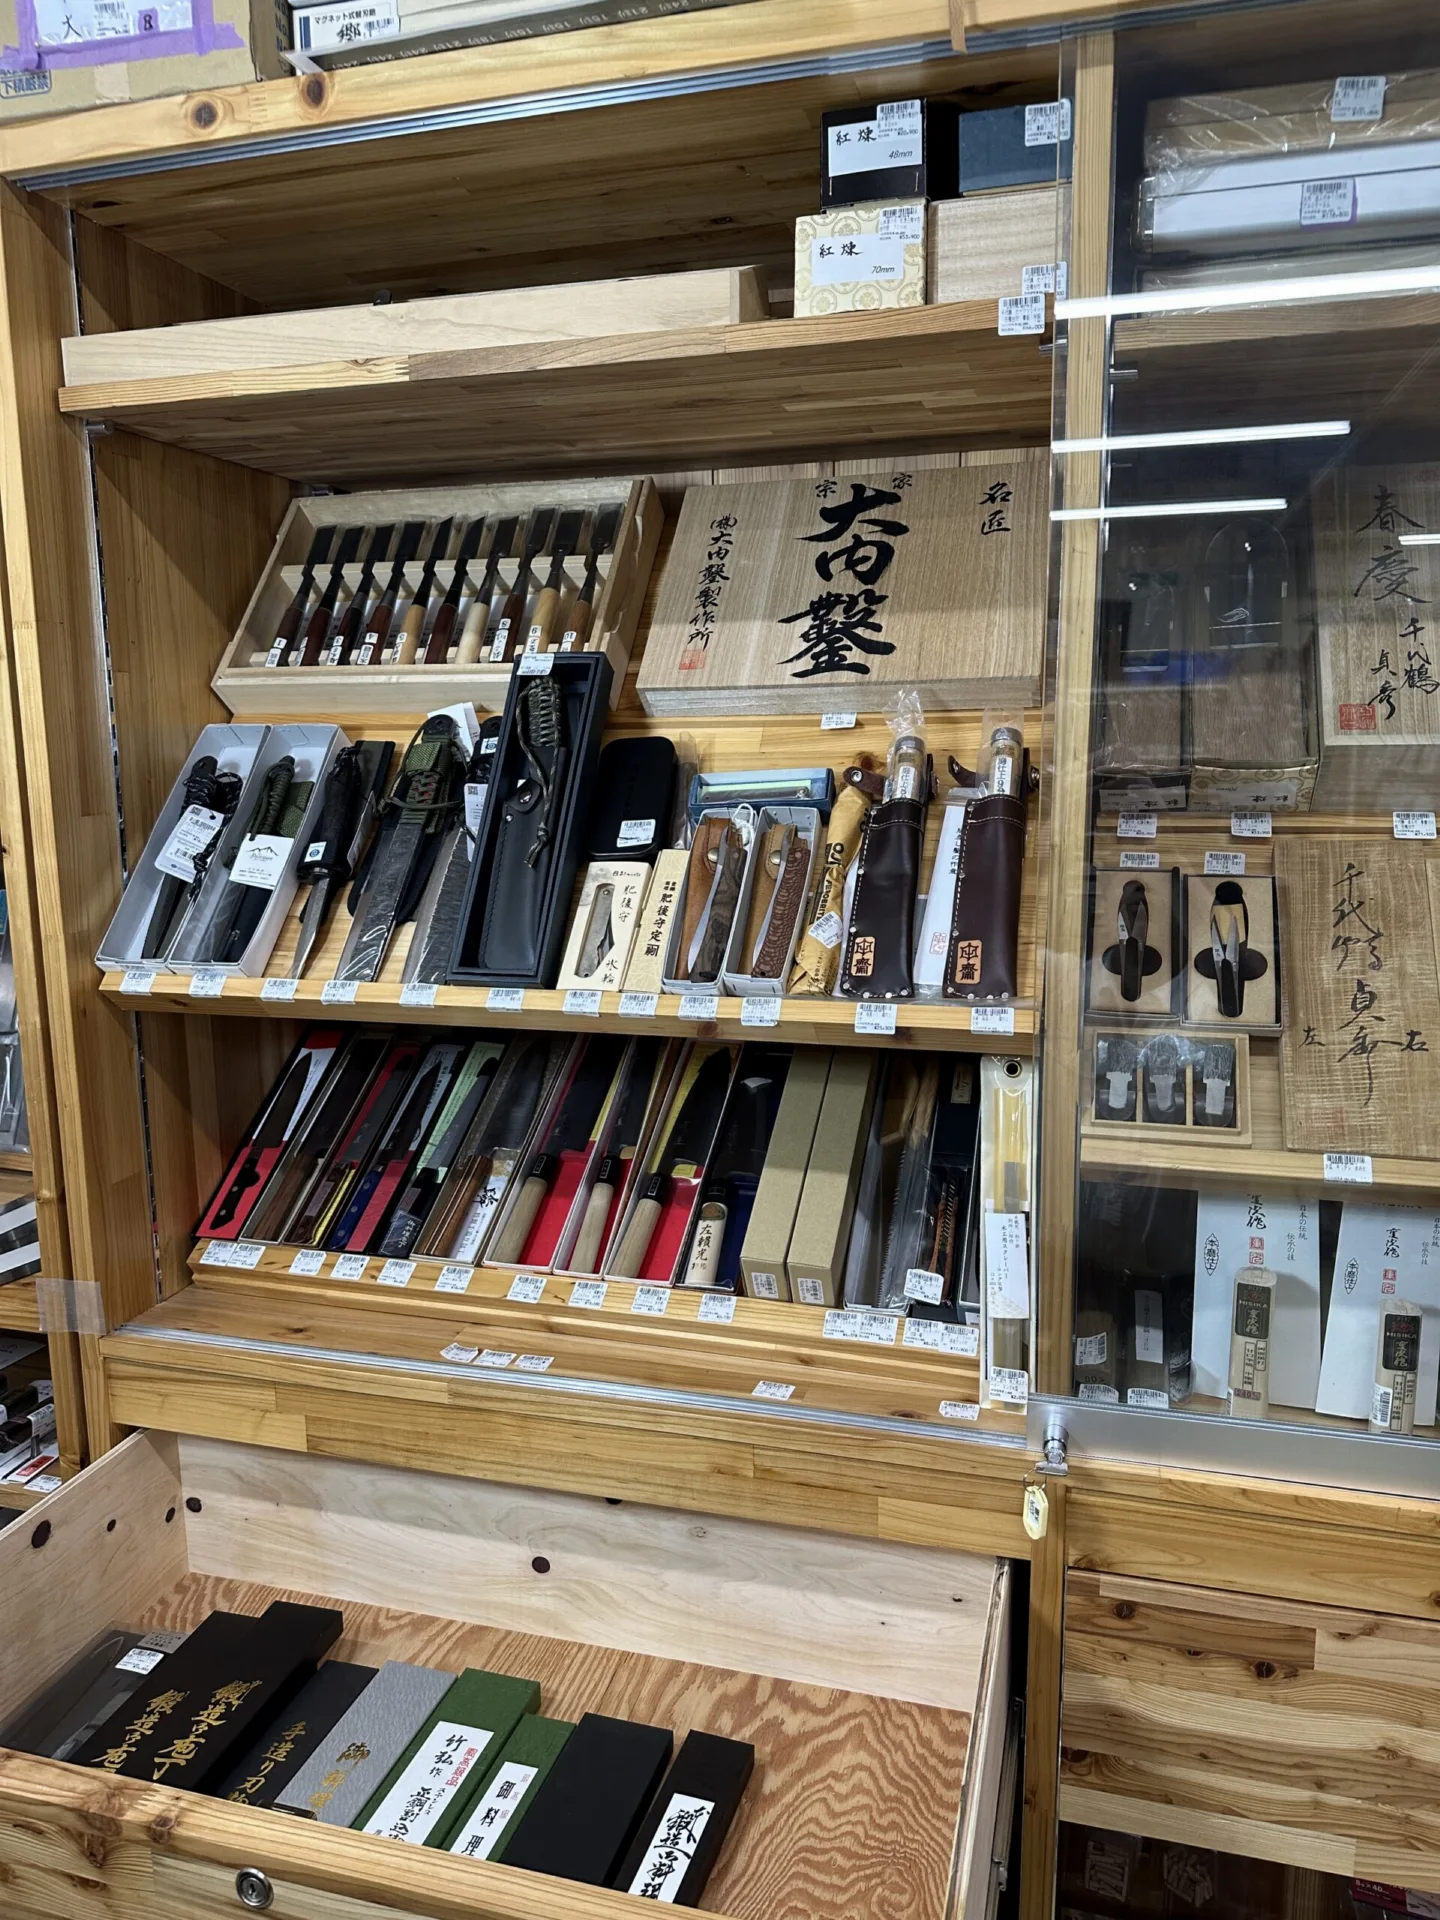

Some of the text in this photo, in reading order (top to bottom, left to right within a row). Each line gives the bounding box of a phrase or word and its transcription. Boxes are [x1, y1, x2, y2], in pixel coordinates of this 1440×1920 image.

[888, 149, 914, 160] 48mm
[871, 264, 896, 275] 70mm
[979, 481, 1013, 536] 名匠
[1298, 1204, 1308, 1240] 日本の伝統
[1238, 1299, 1269, 1309] HISIKA
[1386, 1331, 1419, 1339] HISIKA
[424, 1787, 446, 1815] ステンレス
